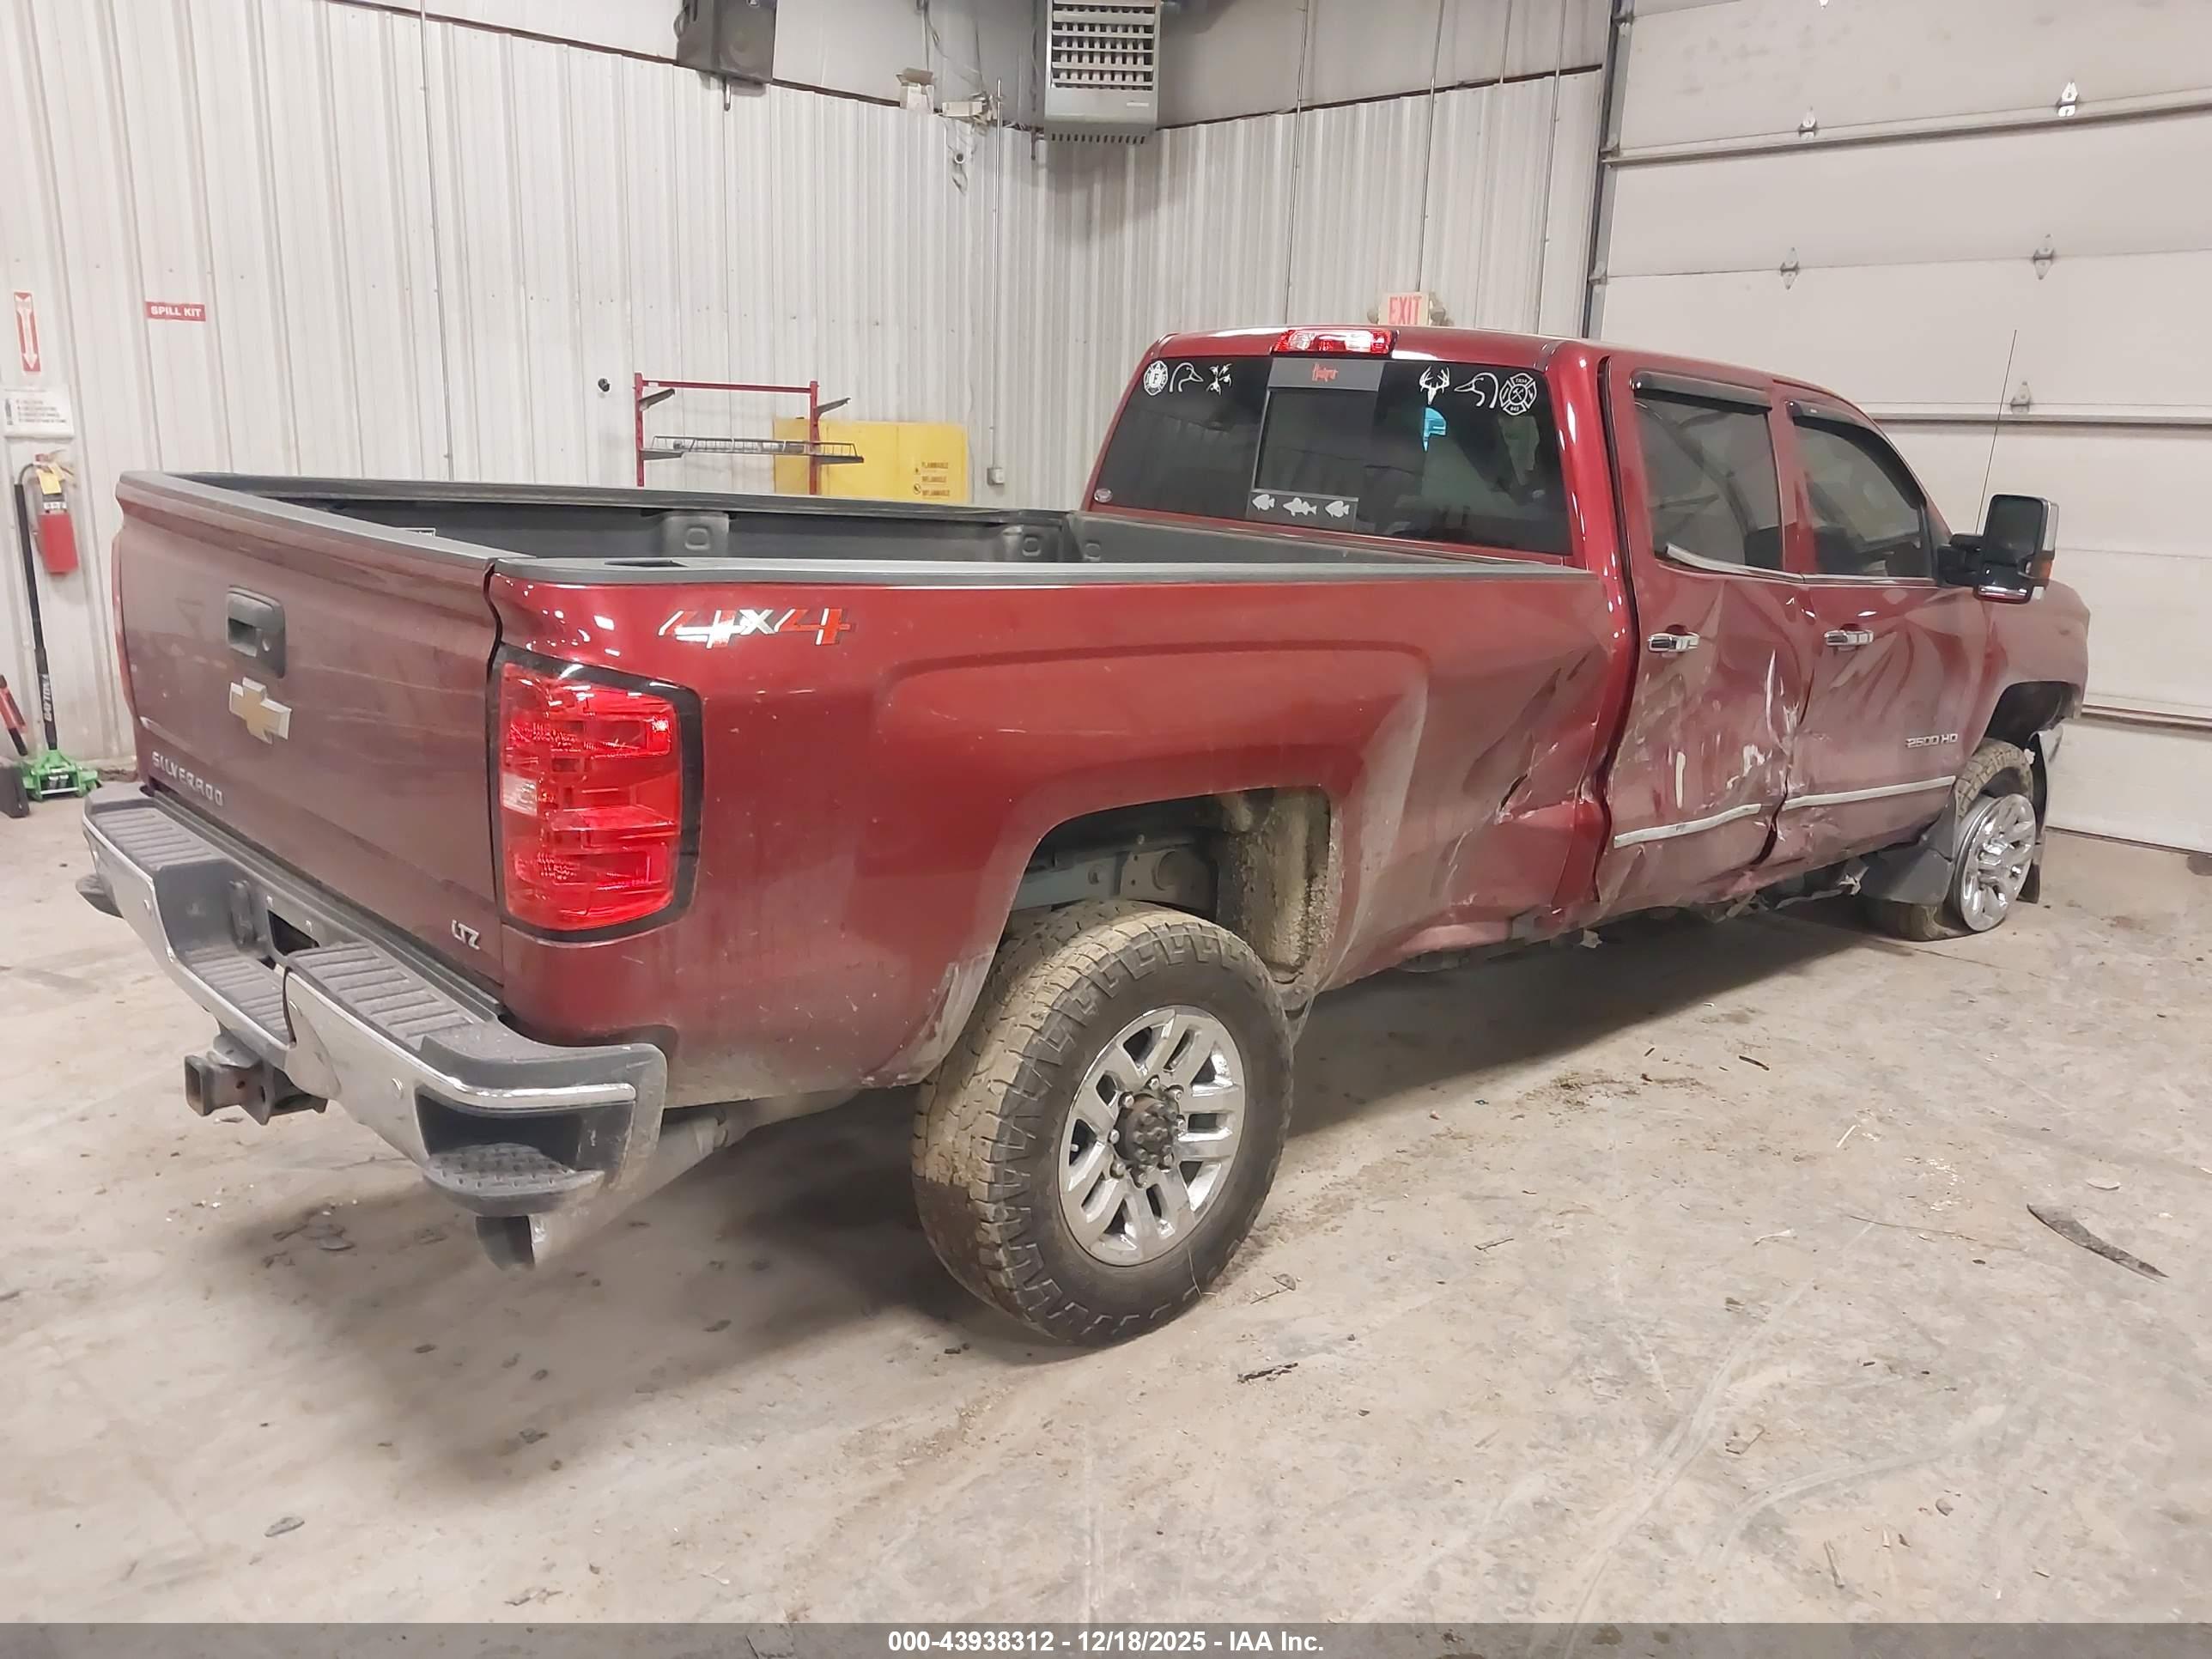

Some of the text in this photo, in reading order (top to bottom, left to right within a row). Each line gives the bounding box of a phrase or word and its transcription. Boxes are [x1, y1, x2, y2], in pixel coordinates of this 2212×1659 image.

[150, 306, 202, 318] SPILL KIT
[1389, 295, 1423, 325] EXIT
[1905, 733, 1958, 749] 2500 HD
[152, 750, 223, 806] SILVERADO
[451, 920, 480, 950] LTZ
